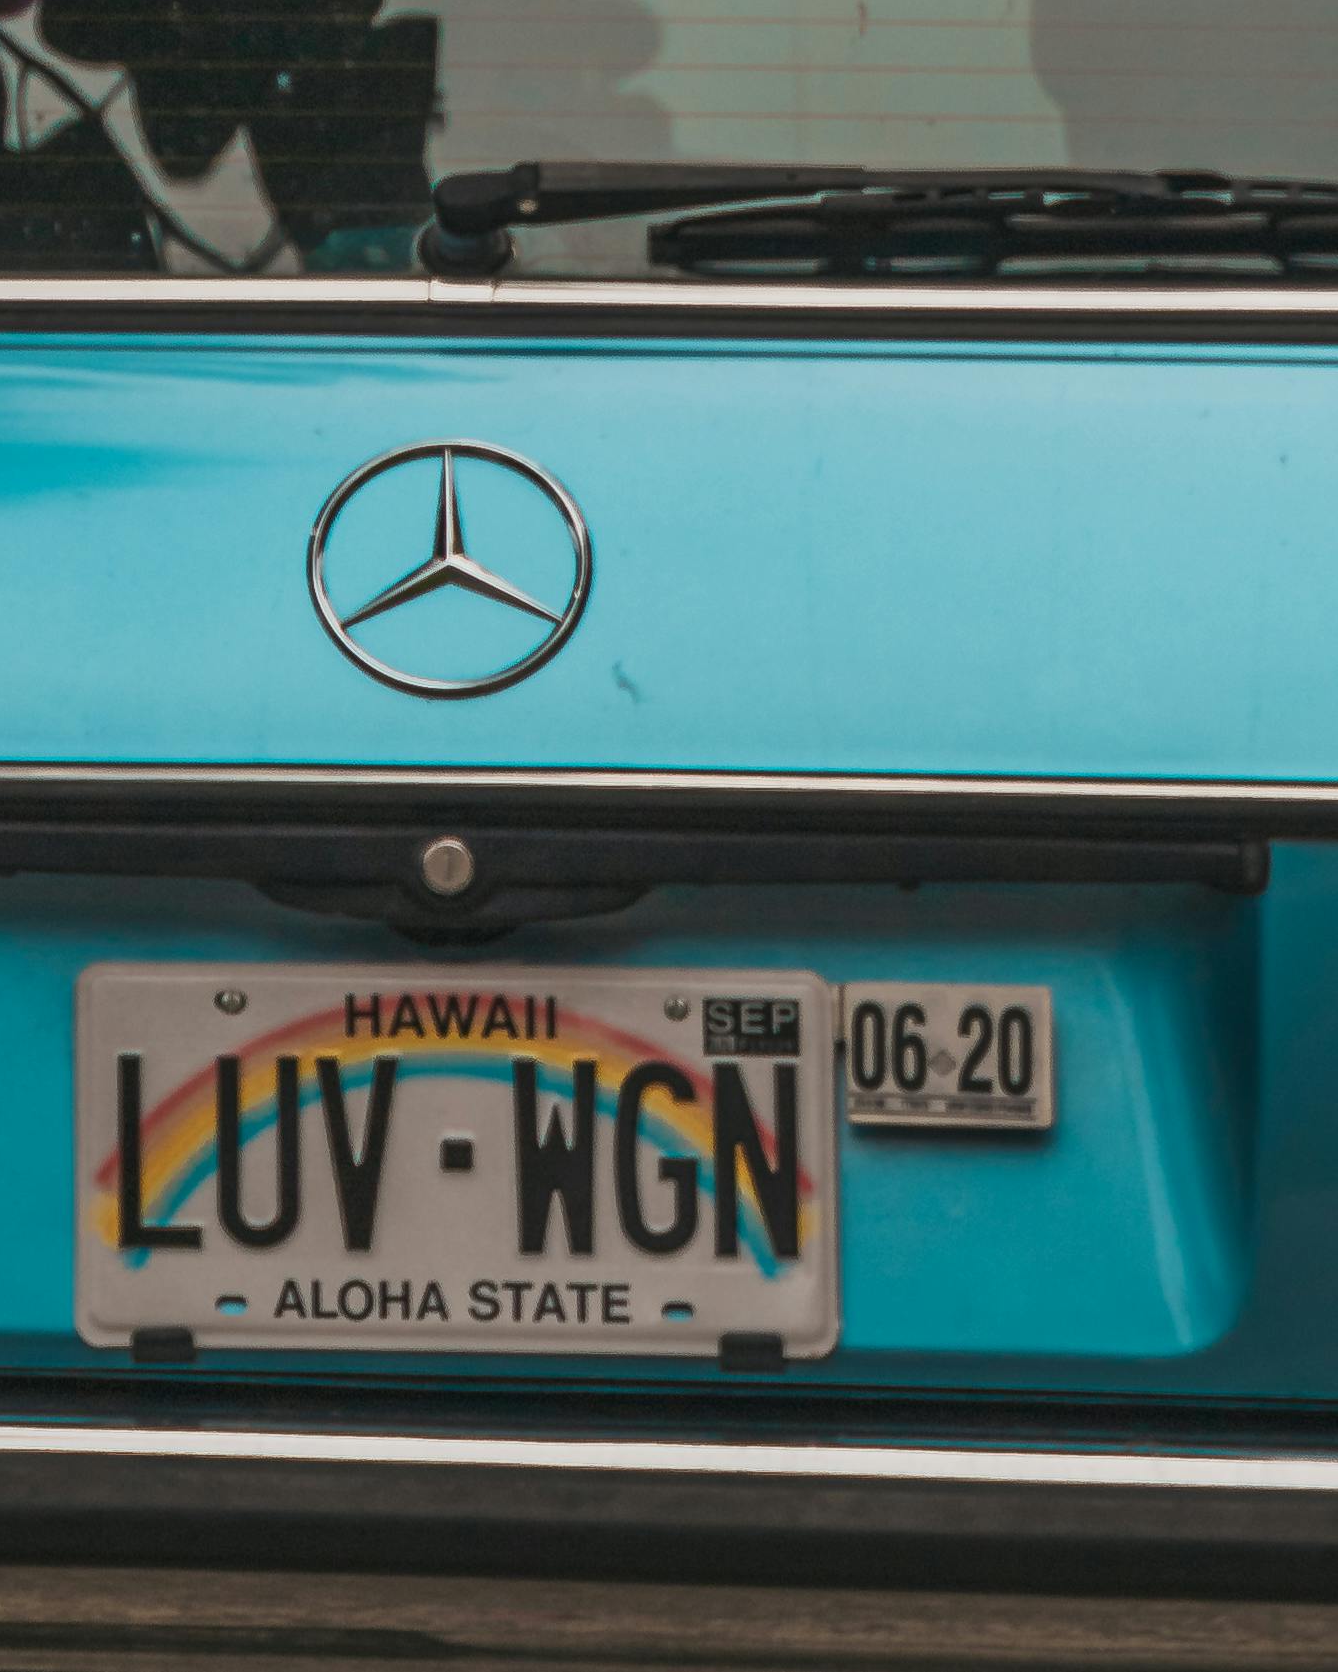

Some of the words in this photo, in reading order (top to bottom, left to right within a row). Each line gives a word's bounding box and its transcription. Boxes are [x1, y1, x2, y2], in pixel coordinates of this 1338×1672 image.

[342, 991, 559, 1041] HAWAII
[707, 1001, 797, 1035] SEP
[850, 1000, 926, 1095] 06
[956, 1003, 1035, 1099] 20
[117, 1053, 402, 1255] LUV
[510, 1059, 802, 1261] WGN
[273, 1277, 450, 1323] ALOHA
[467, 1279, 632, 1325] STATE
